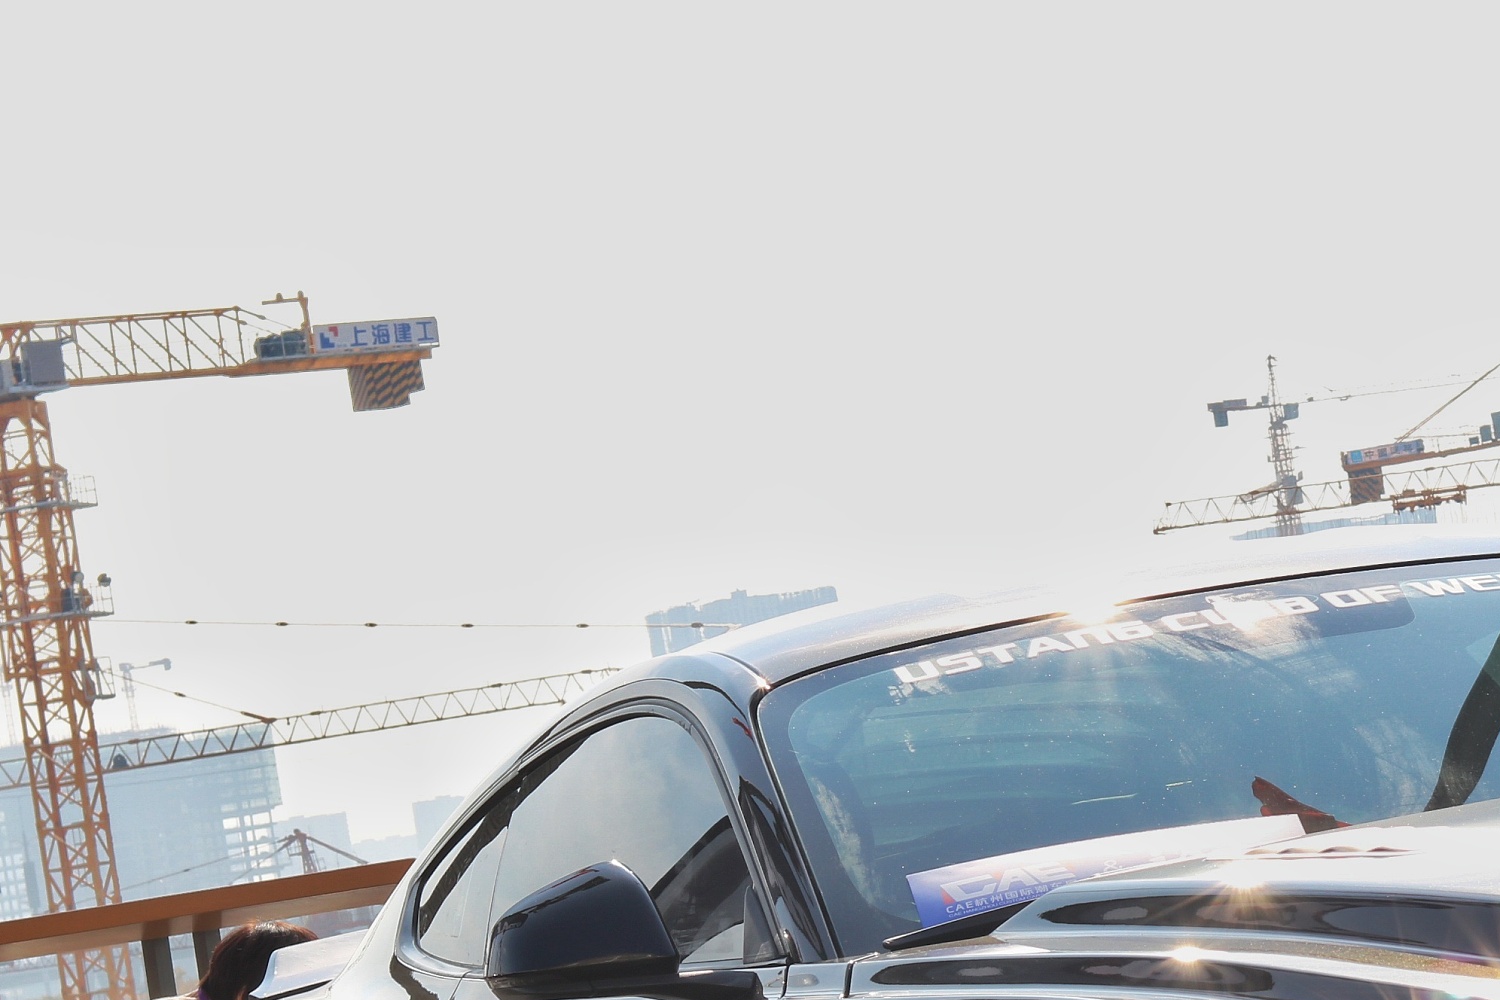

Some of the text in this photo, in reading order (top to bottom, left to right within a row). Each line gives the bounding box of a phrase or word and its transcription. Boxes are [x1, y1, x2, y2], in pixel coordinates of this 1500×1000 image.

[350, 321, 434, 347] 上海建工
[1161, 596, 1320, 632] CLB
[1319, 584, 1403, 609] OF
[940, 861, 1077, 903] CAE
